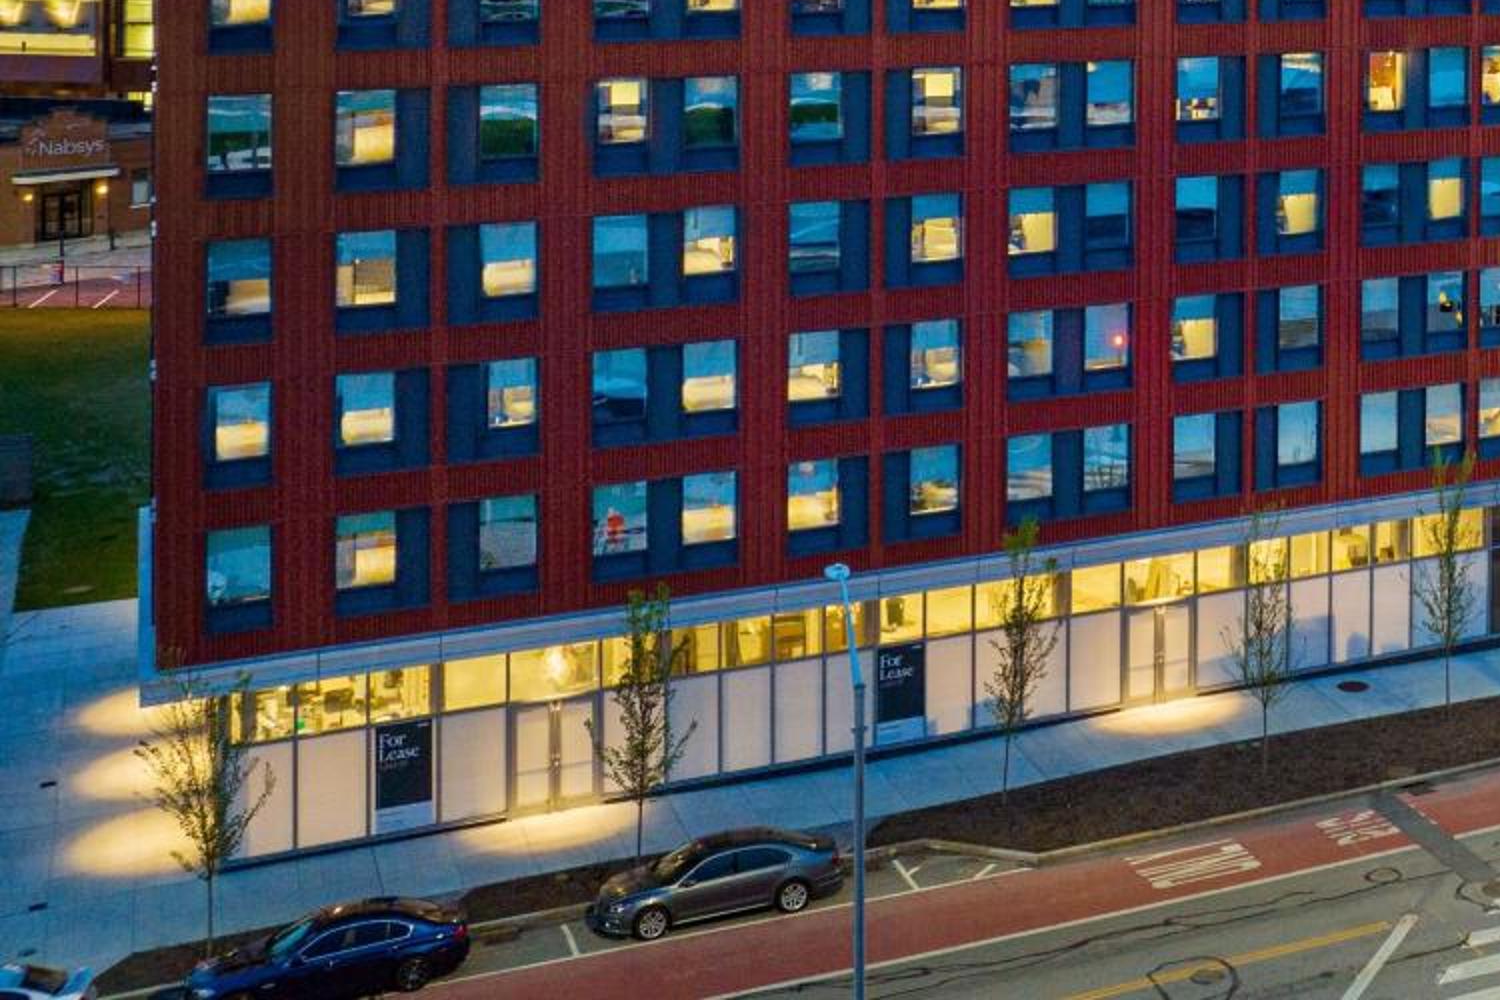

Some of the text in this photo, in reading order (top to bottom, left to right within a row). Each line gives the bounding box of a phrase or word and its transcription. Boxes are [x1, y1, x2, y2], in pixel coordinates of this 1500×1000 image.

[39, 138, 104, 157] Nabsys
[379, 732, 407, 747] For
[379, 745, 420, 761] Lease
